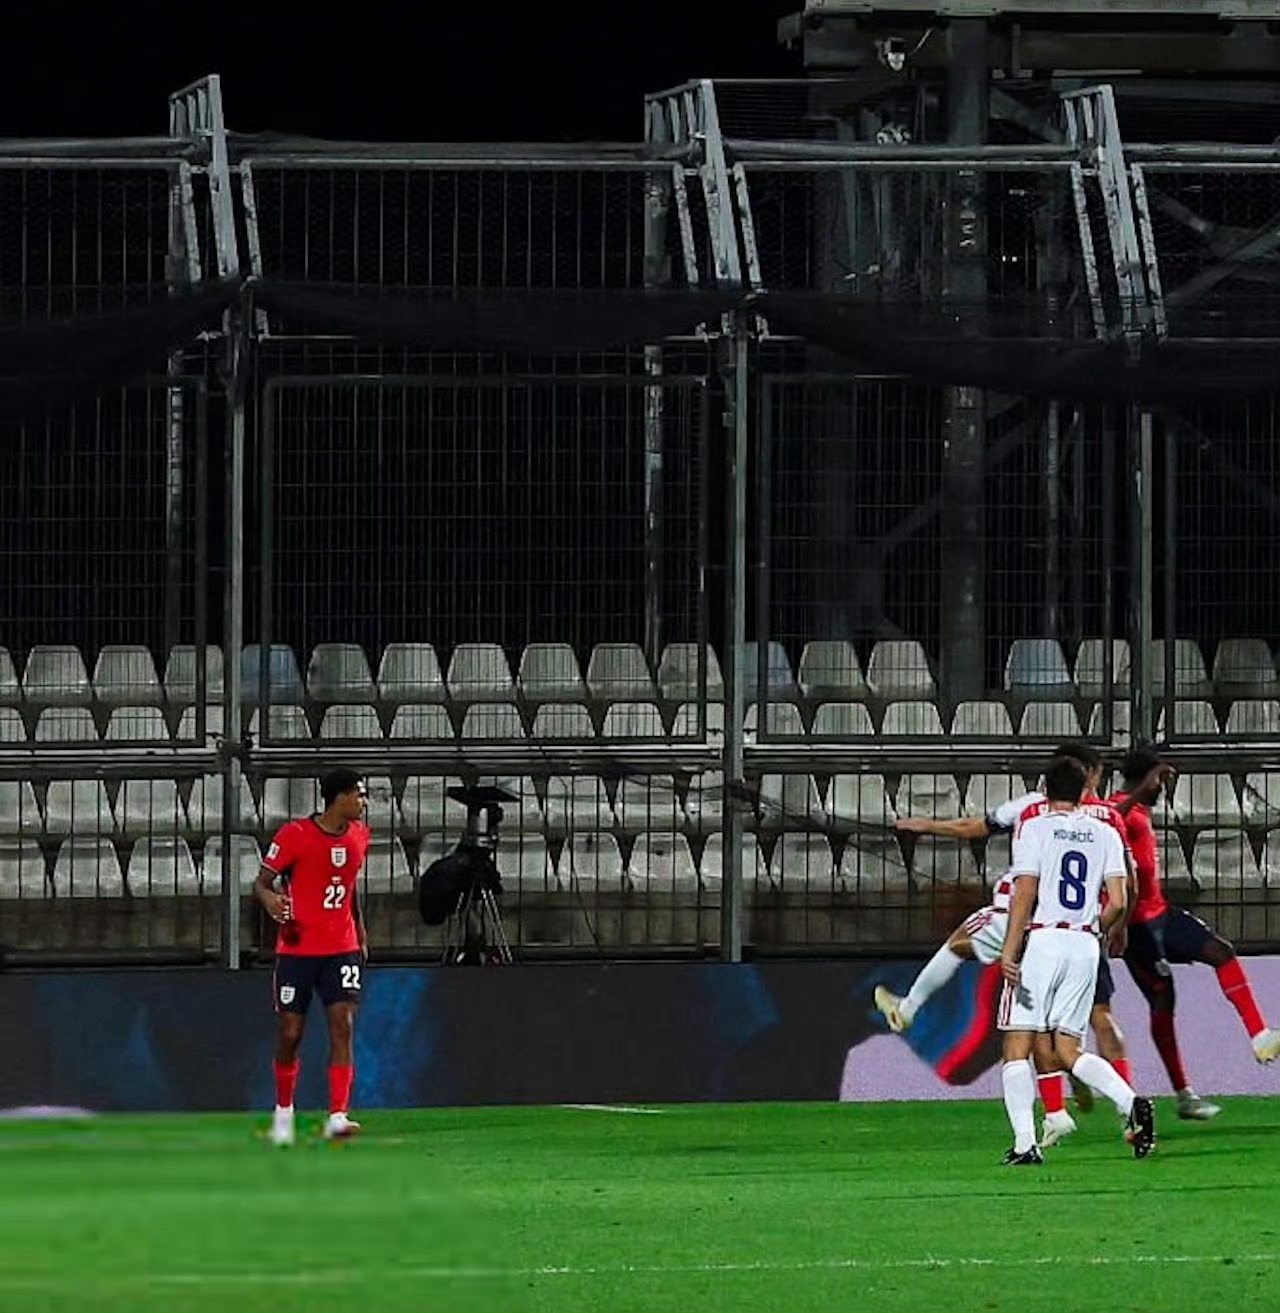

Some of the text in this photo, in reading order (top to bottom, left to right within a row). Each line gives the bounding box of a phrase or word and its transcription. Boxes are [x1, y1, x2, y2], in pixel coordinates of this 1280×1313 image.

[1059, 850, 1088, 910] 8
[323, 884, 346, 909] 22
[340, 964, 362, 990] 22
